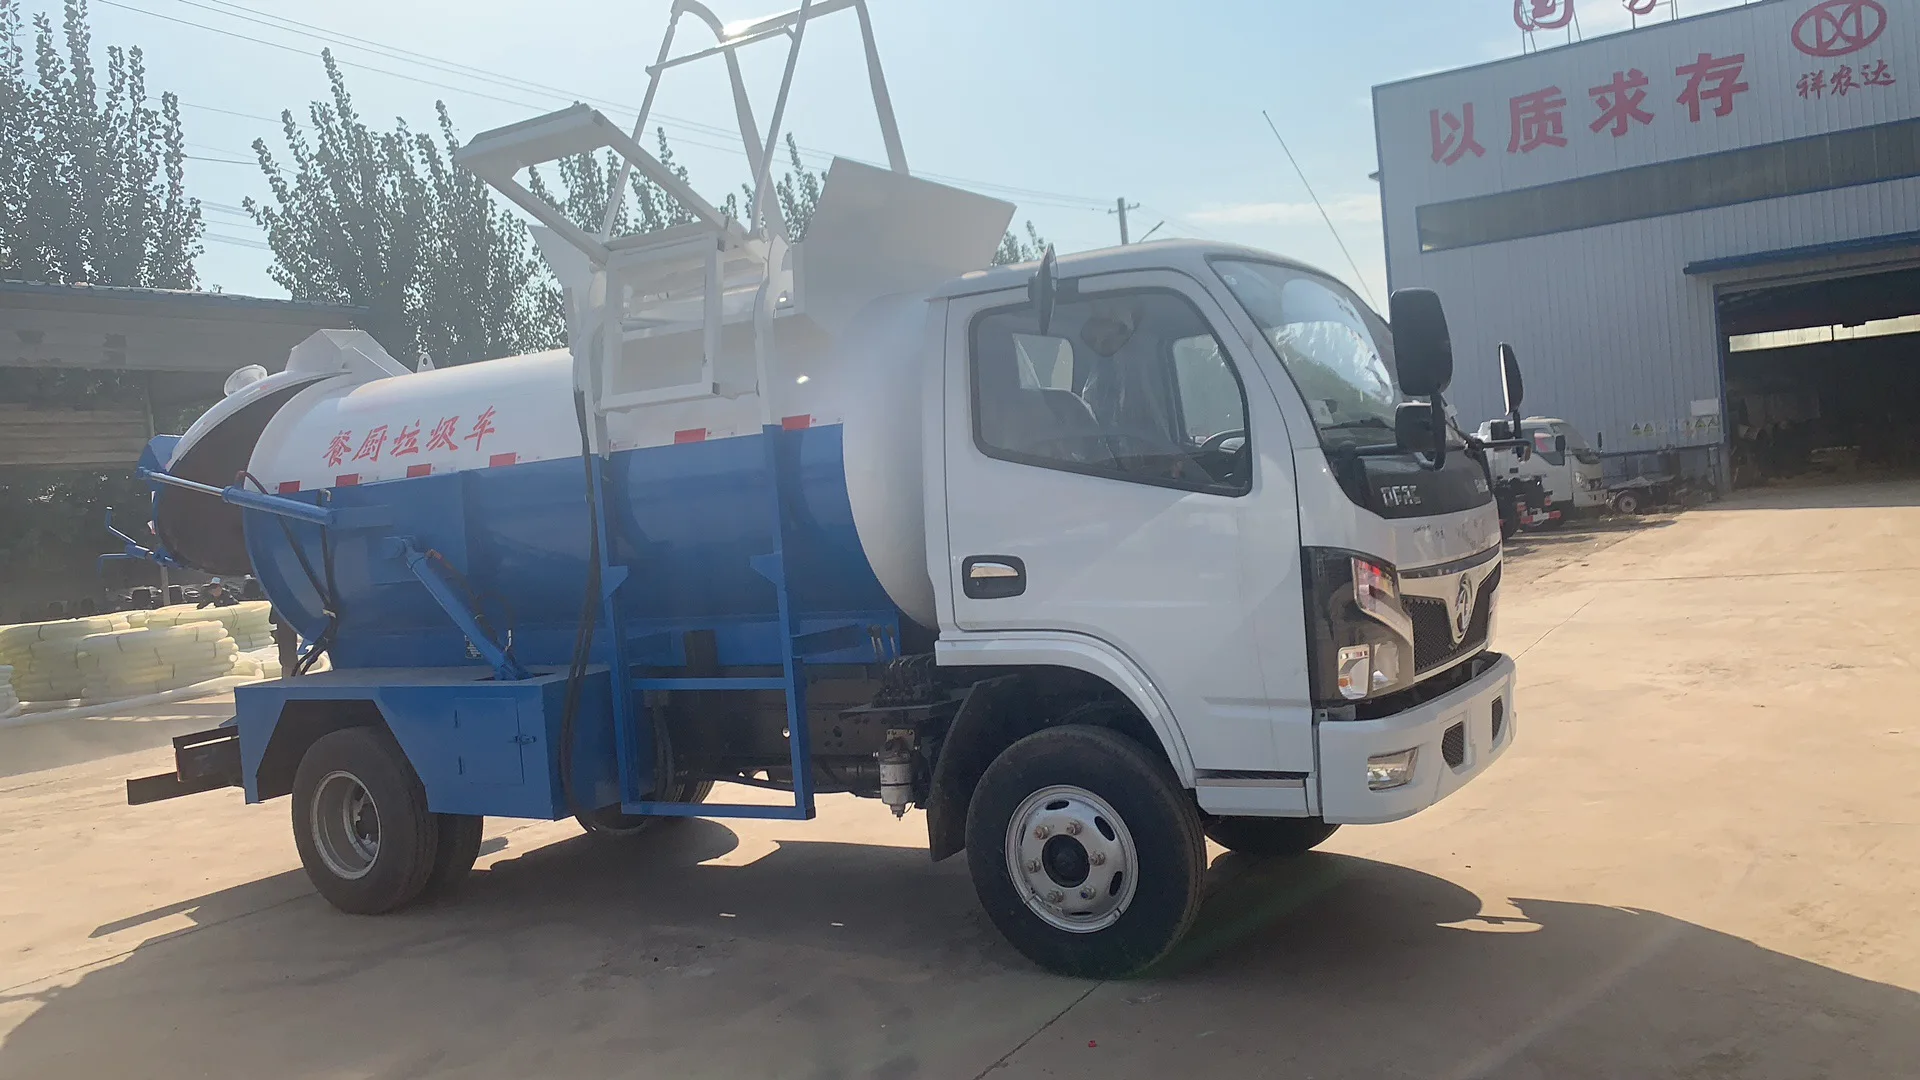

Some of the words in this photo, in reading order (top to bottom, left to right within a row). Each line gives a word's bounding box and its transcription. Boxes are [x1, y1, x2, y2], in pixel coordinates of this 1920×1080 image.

[1430, 53, 1749, 167] 以质求存
[1796, 58, 1896, 100] 祥农达
[322, 405, 496, 468] 餐厨垃圾车
